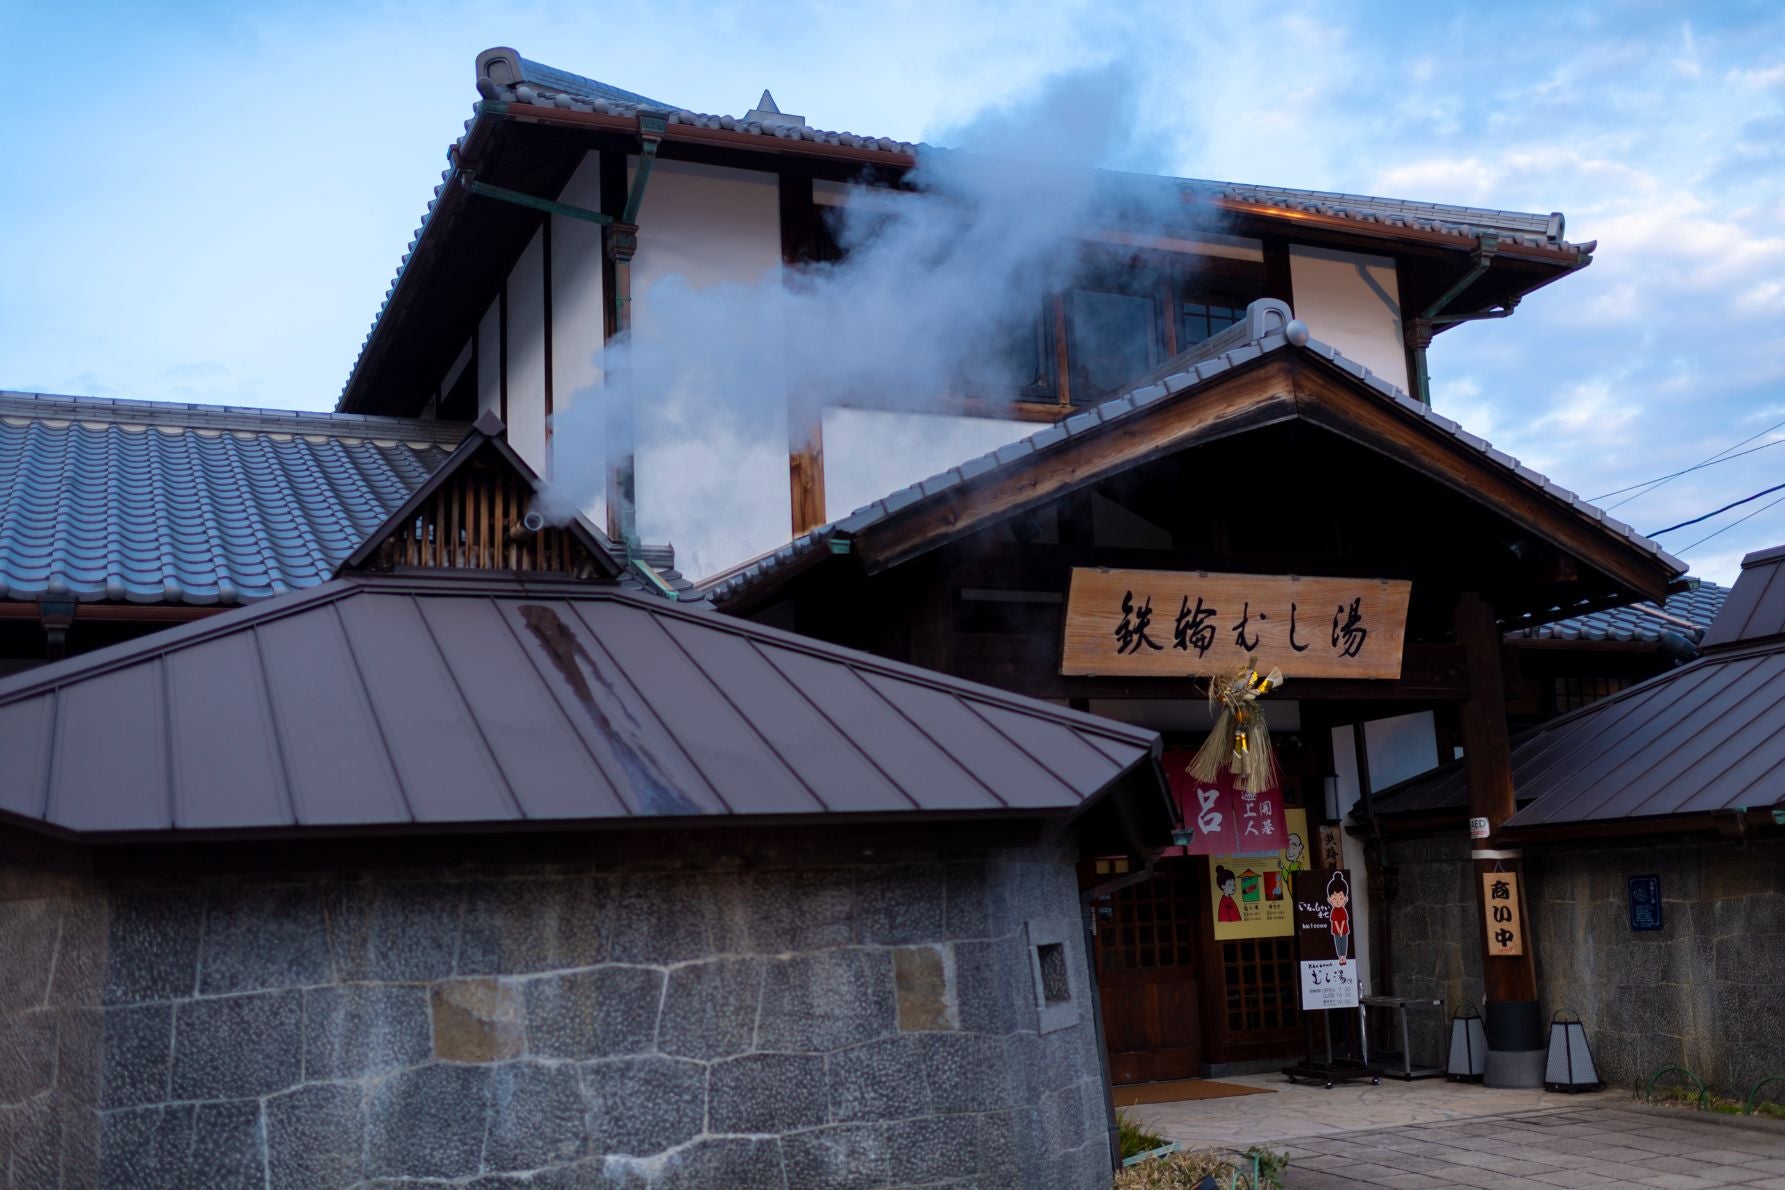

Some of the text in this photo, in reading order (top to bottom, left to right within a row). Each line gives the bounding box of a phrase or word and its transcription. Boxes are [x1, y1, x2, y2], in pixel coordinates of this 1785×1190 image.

[1114, 590, 1368, 659] 鉄輪むし湯
[1197, 788, 1223, 835] 呂
[1491, 880, 1514, 947] 商い中
